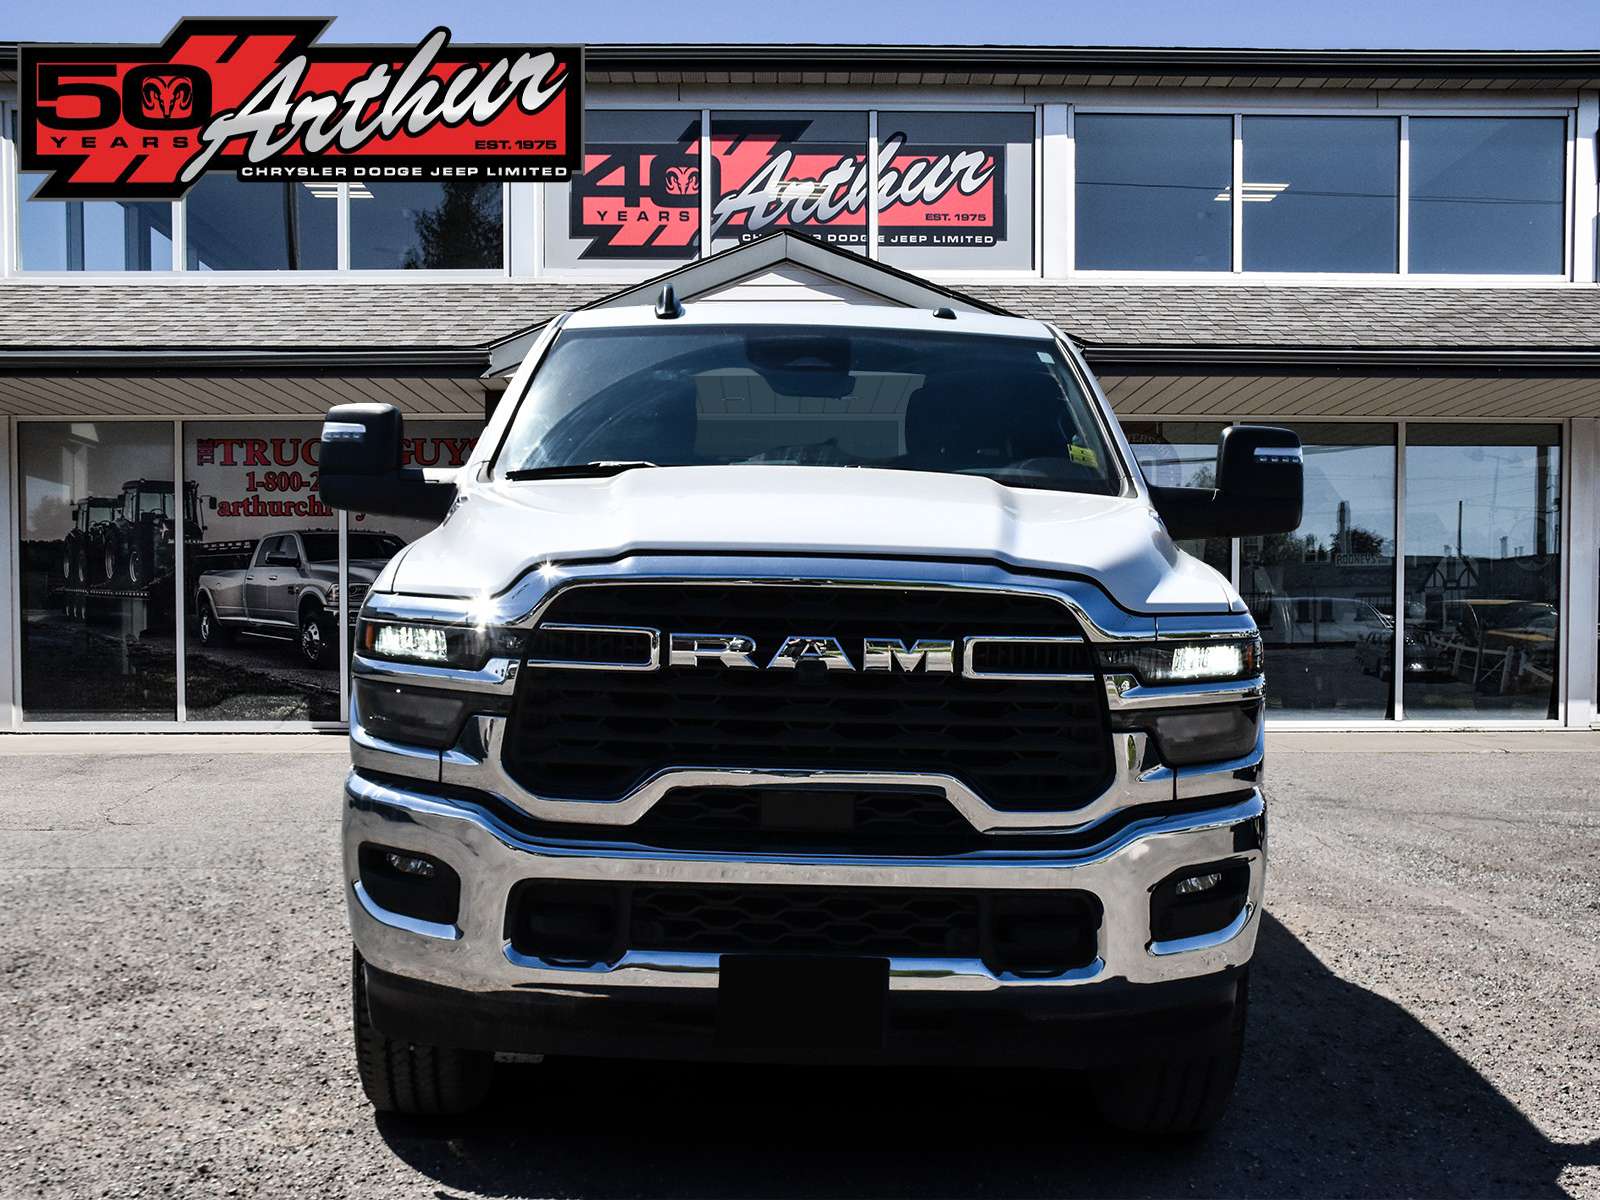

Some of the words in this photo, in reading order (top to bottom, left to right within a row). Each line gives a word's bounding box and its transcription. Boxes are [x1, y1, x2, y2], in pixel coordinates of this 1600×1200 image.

[583, 153, 721, 208] 40
[694, 136, 995, 240] Arthur
[597, 210, 691, 222] YEARS
[924, 212, 951, 222] EST.
[954, 212, 987, 222] 1975
[890, 234, 928, 243] JEEP
[933, 234, 994, 244] LIMITED
[216, 438, 321, 467] TRUC
[245, 470, 321, 493] 1-800-2
[669, 632, 954, 673] RAM
